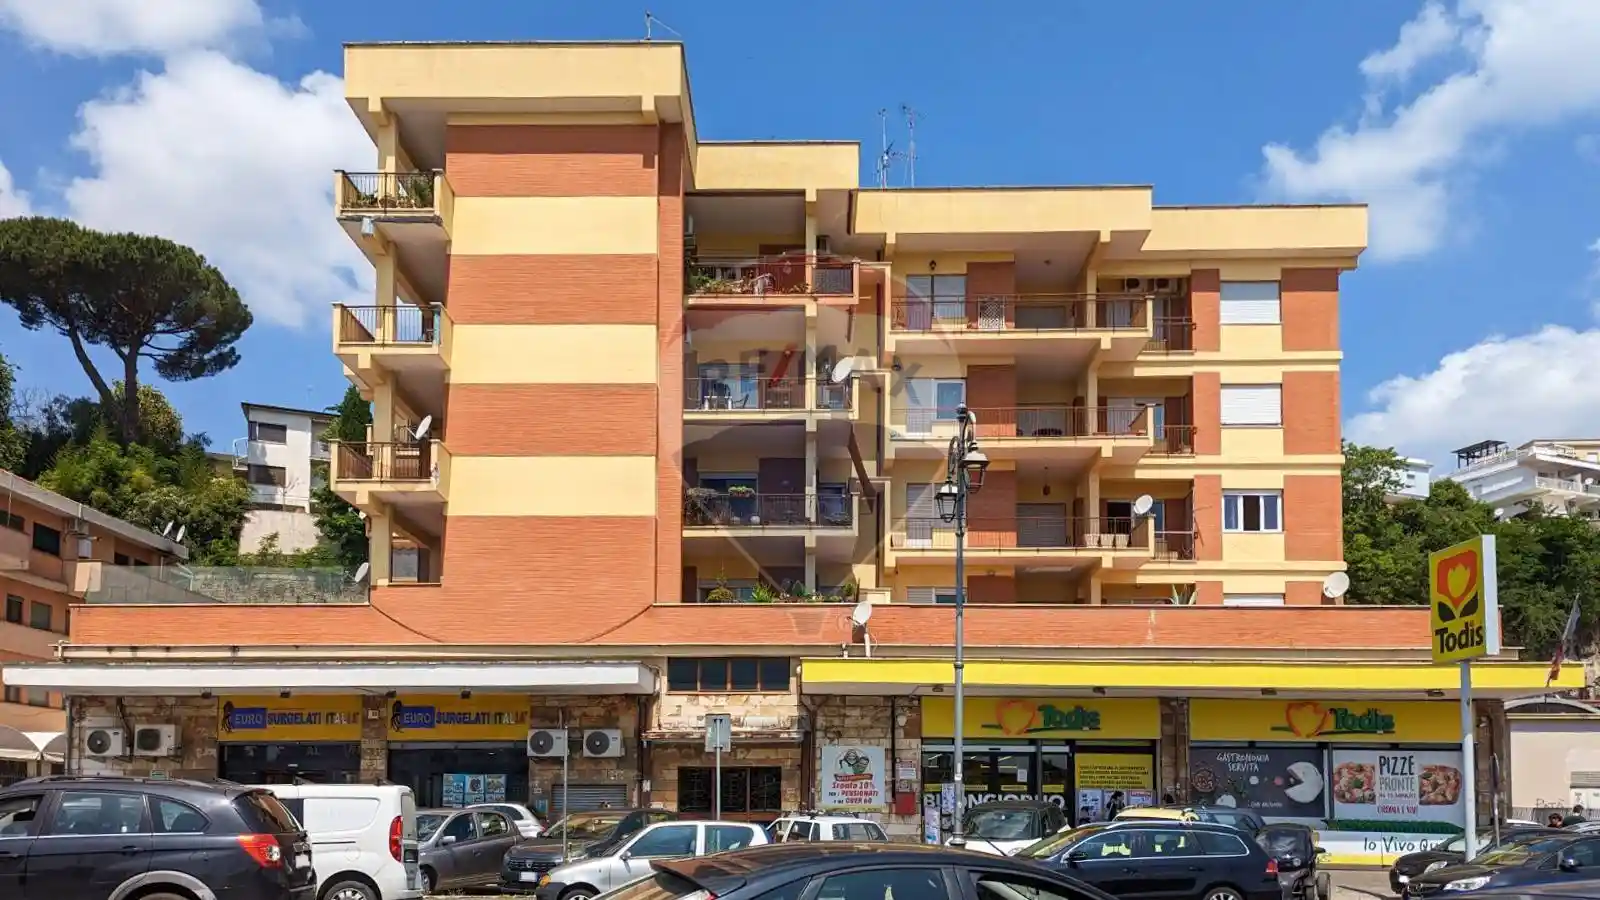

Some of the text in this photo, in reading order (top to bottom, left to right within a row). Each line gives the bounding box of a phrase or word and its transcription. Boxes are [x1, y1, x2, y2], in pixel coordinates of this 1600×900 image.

[1435, 620, 1484, 653] Todis
[235, 713, 263, 725] EURO
[267, 712, 322, 725] SURGELATI
[403, 712, 431, 725] EURO
[436, 711, 490, 725] SURGELATI
[1037, 704, 1100, 729] Todis
[1328, 707, 1395, 731] Todis
[1216, 752, 1270, 762] GASTRONOMIA
[1379, 755, 1415, 776] PIZZE
[1379, 776, 1415, 791] PRONTE
[1382, 836, 1416, 853] Vivo
[1419, 837, 1443, 852] Qu
